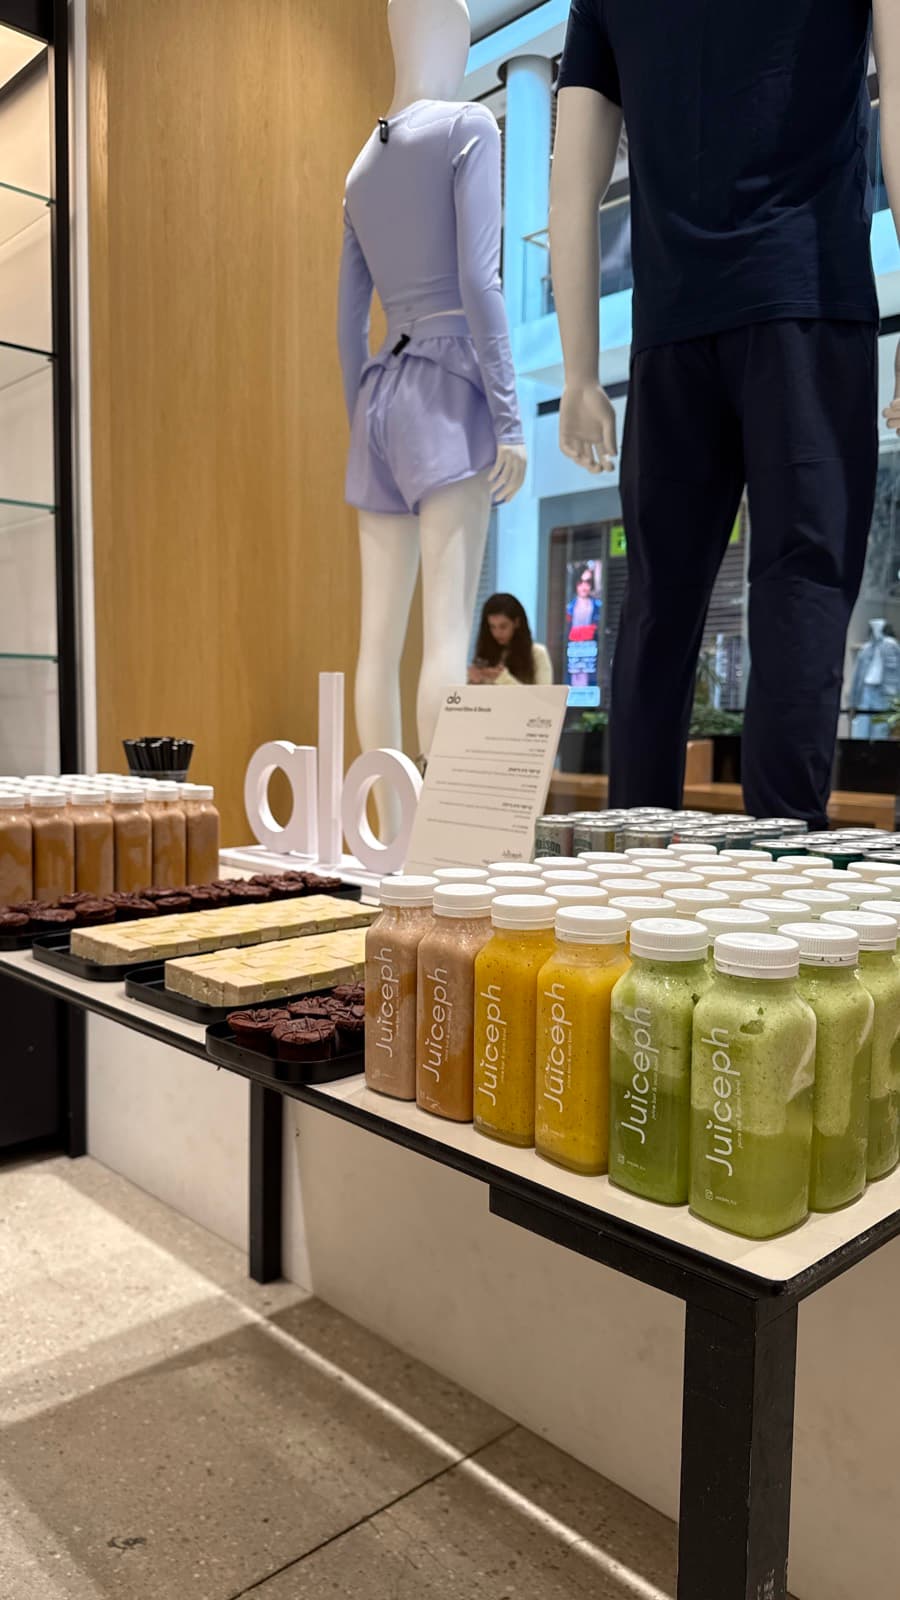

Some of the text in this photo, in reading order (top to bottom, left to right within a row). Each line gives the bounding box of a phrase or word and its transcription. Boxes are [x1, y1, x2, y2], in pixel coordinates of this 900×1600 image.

[244, 672, 424, 874] alo
[374, 947, 399, 1058] Juiceph
[422, 967, 453, 1082] Juiceph
[478, 984, 507, 1106] Juiceph
[543, 982, 572, 1113] Juiceph
[621, 1007, 659, 1144] Juiceph
[701, 1027, 741, 1176] Juiceph
